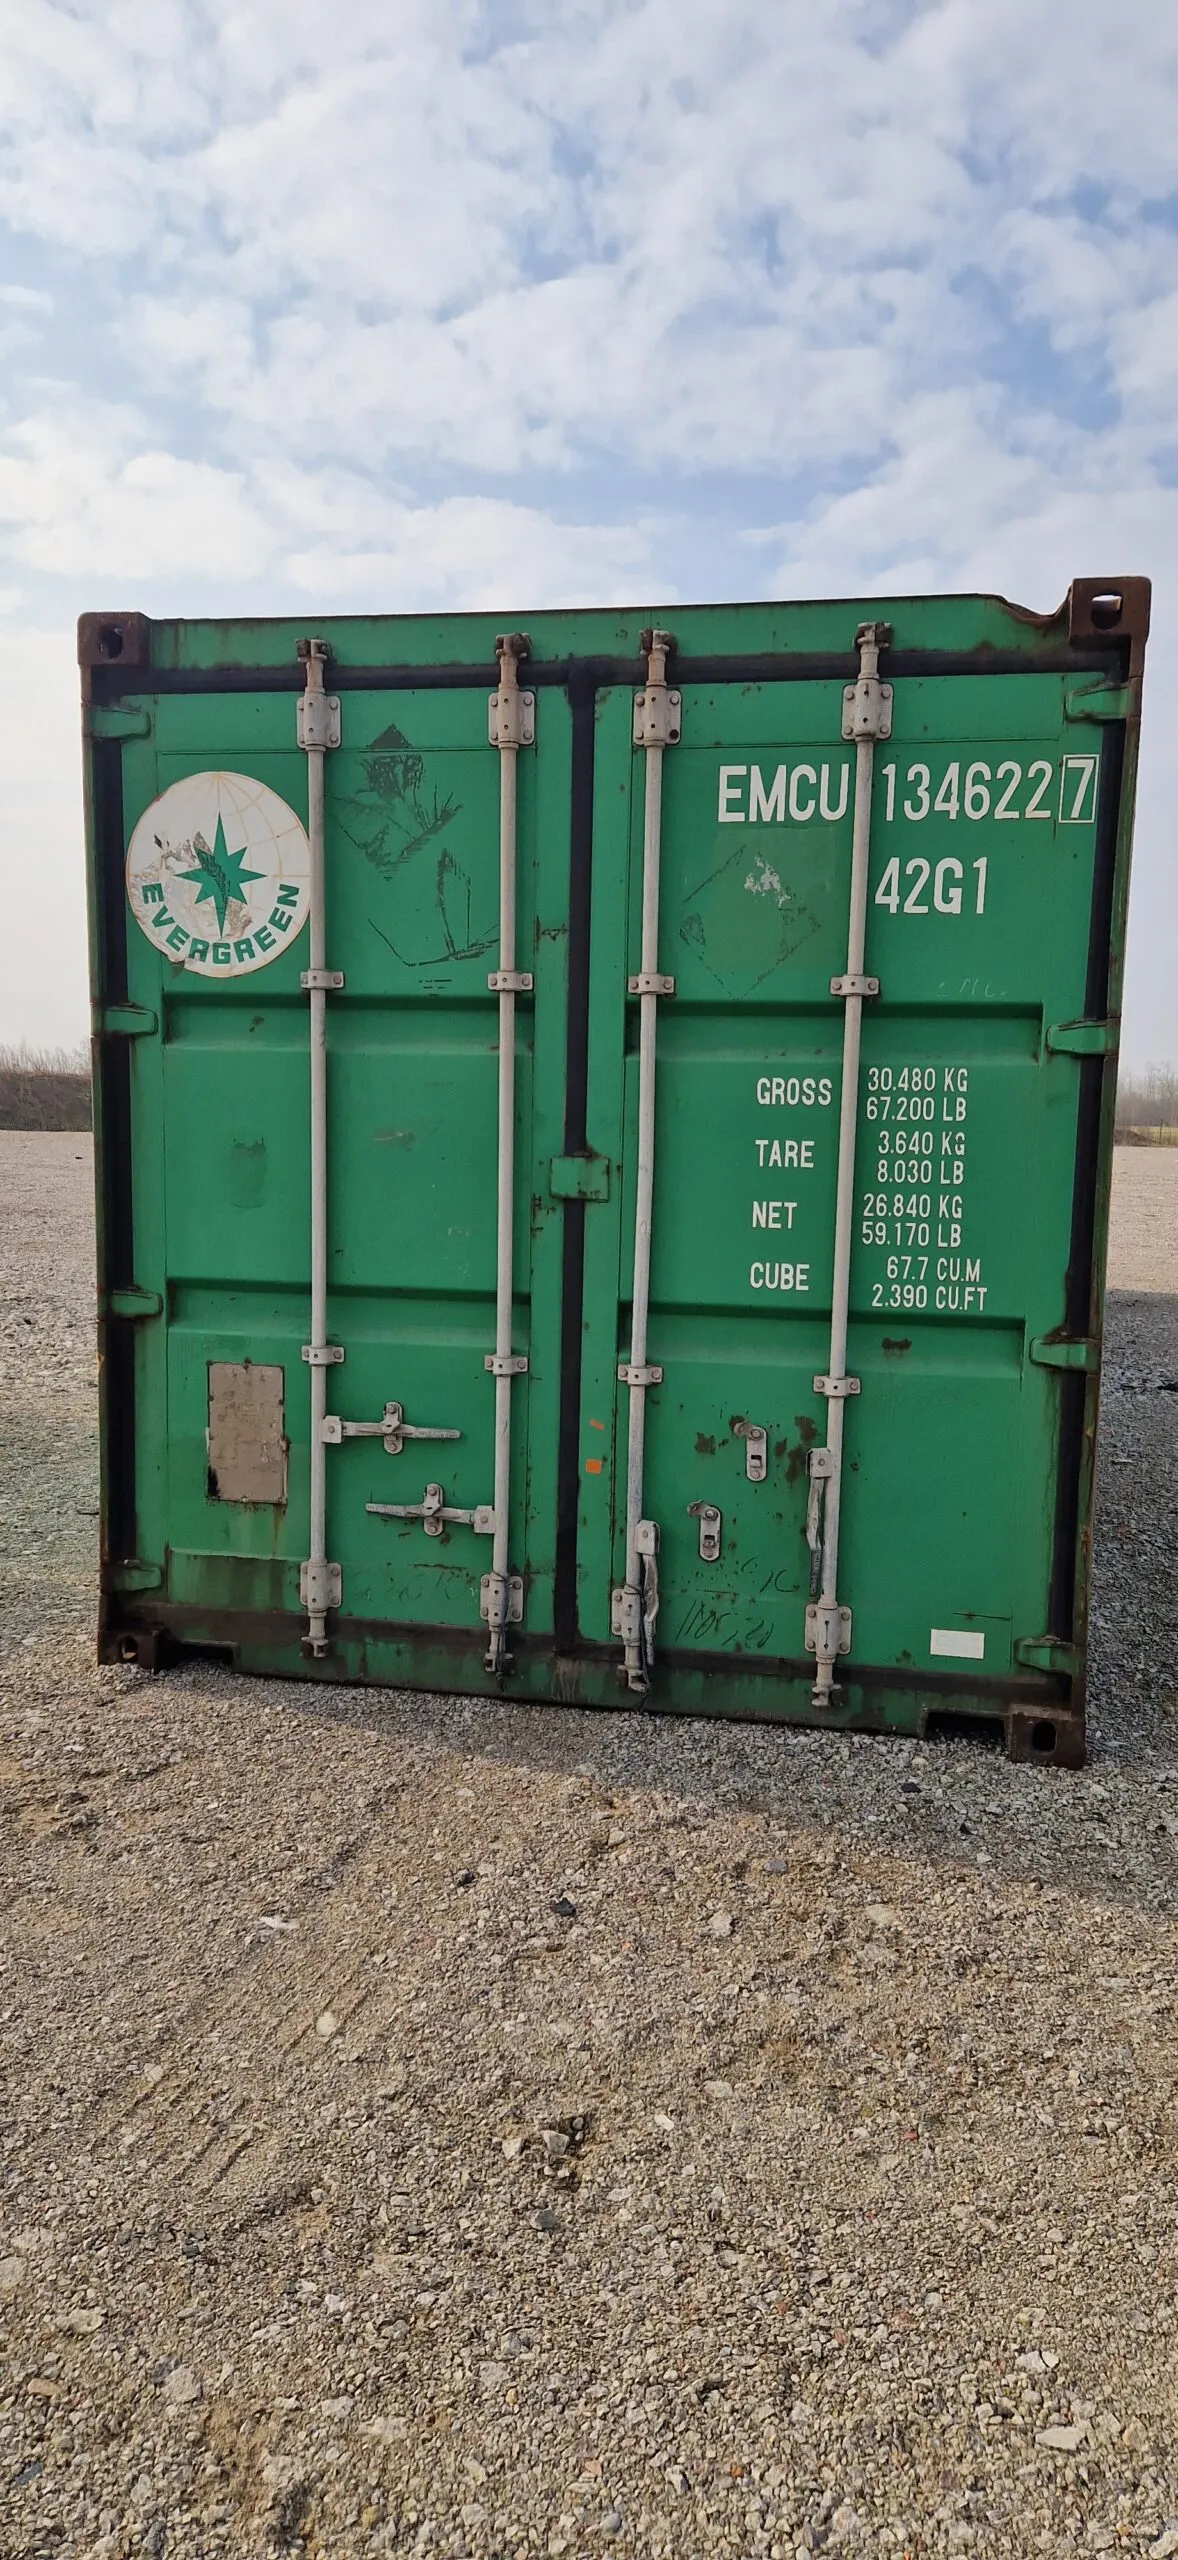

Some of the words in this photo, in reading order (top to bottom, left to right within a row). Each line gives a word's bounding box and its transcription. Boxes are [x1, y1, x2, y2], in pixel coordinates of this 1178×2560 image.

[717, 763, 850, 823] EMCU
[874, 856, 988, 914] 42G1
[142, 883, 300, 965] EVERGREEN
[756, 1077, 833, 1106] GROSS
[868, 1067, 936, 1092] 30.480
[944, 1067, 968, 1092] KG
[866, 1096, 935, 1121] 67.200
[942, 1097, 967, 1122] LB
[755, 1139, 815, 1168] TARE
[878, 1130, 933, 1155] 3.640
[941, 1131, 965, 1156] KG
[877, 1159, 932, 1184] 8.030
[940, 1160, 964, 1185] LB
[752, 1200, 798, 1229] NET
[863, 1193, 931, 1218] 26.840
[939, 1194, 963, 1219] KG
[862, 1221, 930, 1247] 59.170
[937, 1223, 961, 1248] LB
[750, 1262, 810, 1291] CUBE
[886, 1255, 929, 1280] 67.7
[937, 1257, 981, 1282] CU.M
[871, 1283, 928, 1308] 2.390
[935, 1285, 988, 1311] CU.FT
